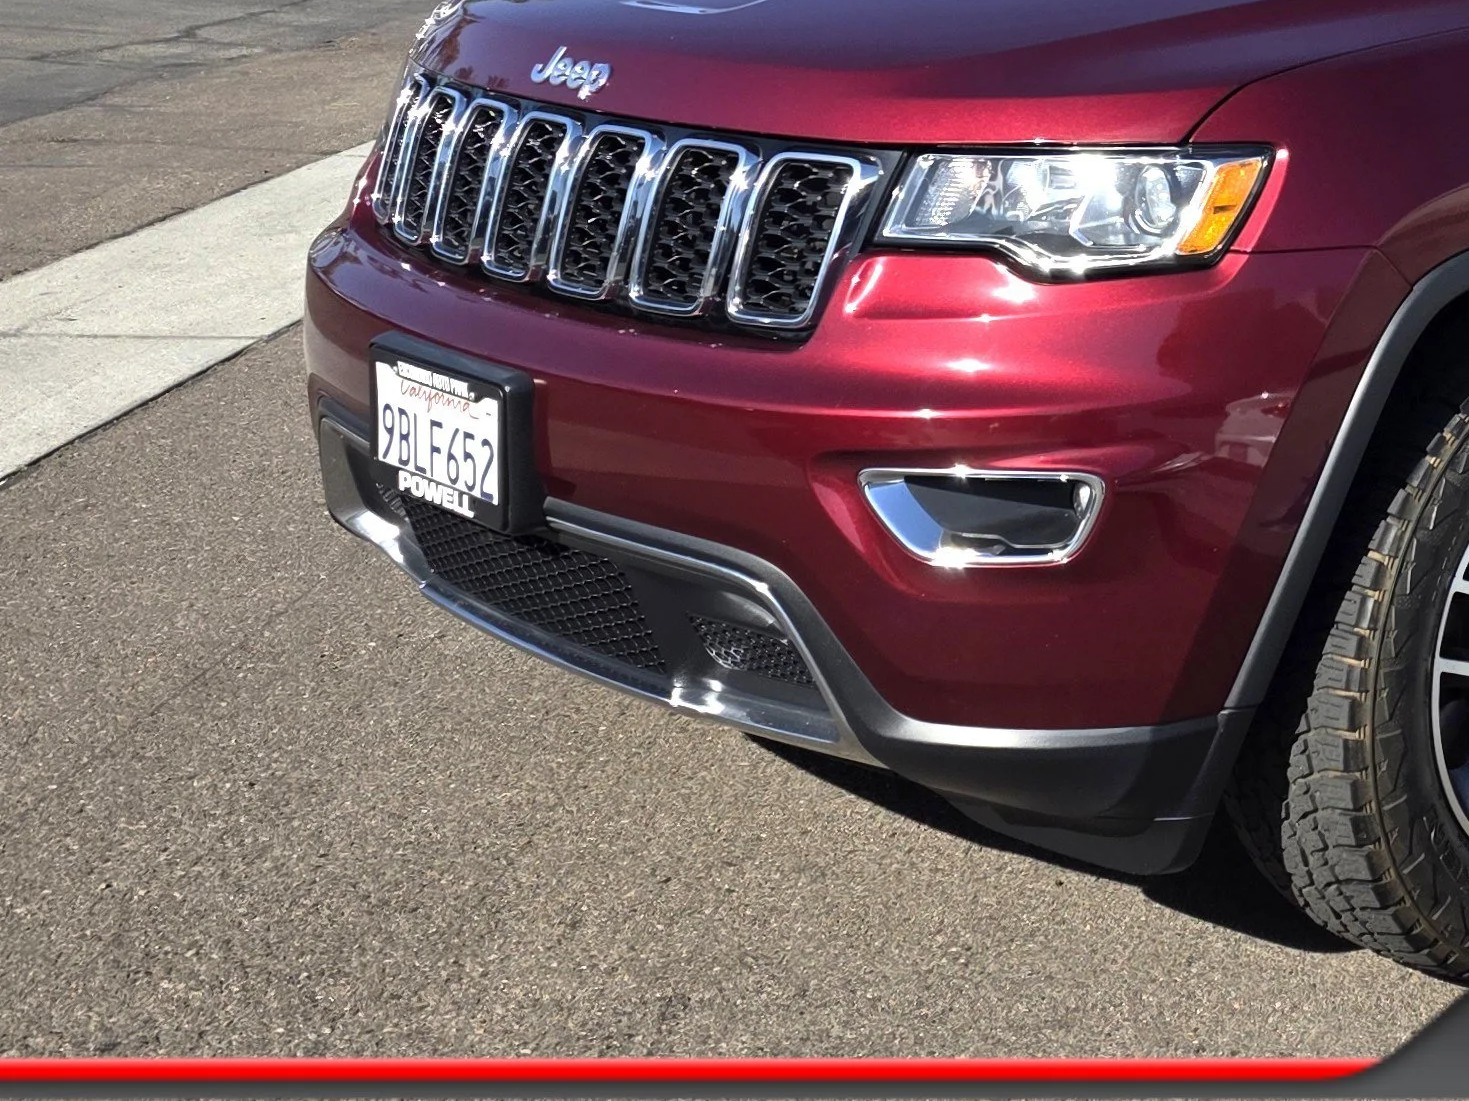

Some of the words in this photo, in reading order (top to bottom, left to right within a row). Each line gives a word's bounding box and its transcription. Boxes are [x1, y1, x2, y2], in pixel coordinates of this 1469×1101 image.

[530, 45, 611, 101] Jeep
[382, 403, 494, 502] 9BLF652
[398, 469, 475, 519] POWELL
